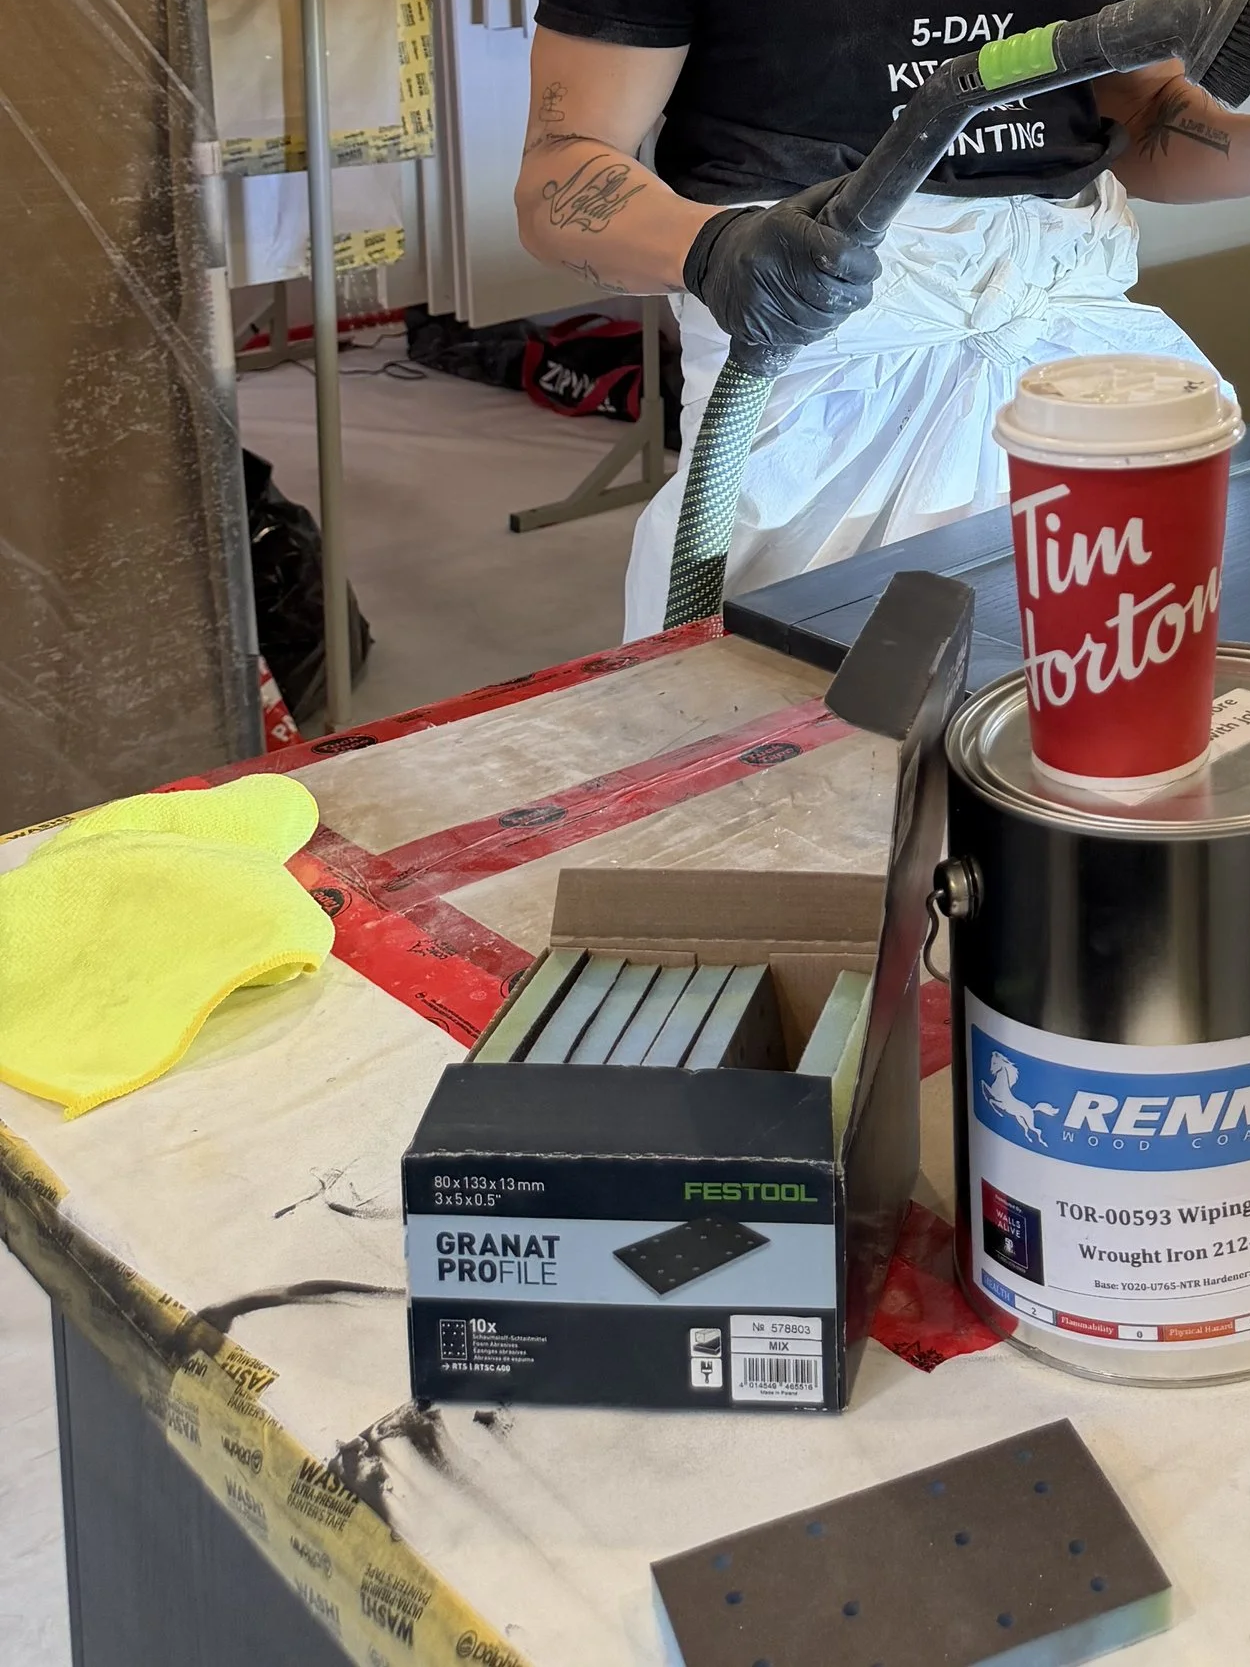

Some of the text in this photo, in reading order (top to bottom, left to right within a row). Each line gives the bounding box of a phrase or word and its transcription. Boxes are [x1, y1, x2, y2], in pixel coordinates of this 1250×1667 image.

[911, 13, 1014, 47] 5-DAY
[1012, 483, 1152, 600] Tim
[1061, 1131, 1151, 1151] WOOD
[517, 1181, 545, 1192] mm
[684, 1182, 818, 1202] FESTOOL
[996, 1209, 1021, 1228] WALLS
[1056, 1200, 1172, 1226] TOR-00593
[997, 1221, 1021, 1238] ALIVE
[436, 1231, 560, 1259] GRANAT
[1079, 1243, 1163, 1267] Wrought
[1167, 1245, 1209, 1263] Iron
[438, 1258, 558, 1286] PROFILE
[984, 1273, 1012, 1303] HEALTH
[1094, 1280, 1119, 1290] Base:
[1031, 1306, 1037, 1316] 2
[470, 1318, 497, 1333] 10x
[771, 1323, 811, 1335] 578803
[1060, 1315, 1115, 1336] Flammability
[1136, 1330, 1143, 1339] 0
[1169, 1321, 1233, 1339] Physical Hazard
[769, 1341, 789, 1351] MIX
[452, 1362, 511, 1372] RTS RTSC 400
[291, 1480, 356, 1518] ULTRA-PREMIUM
[287, 1494, 349, 1532] PAINTER'S TAPE
[360, 1591, 415, 1650] WASHI
